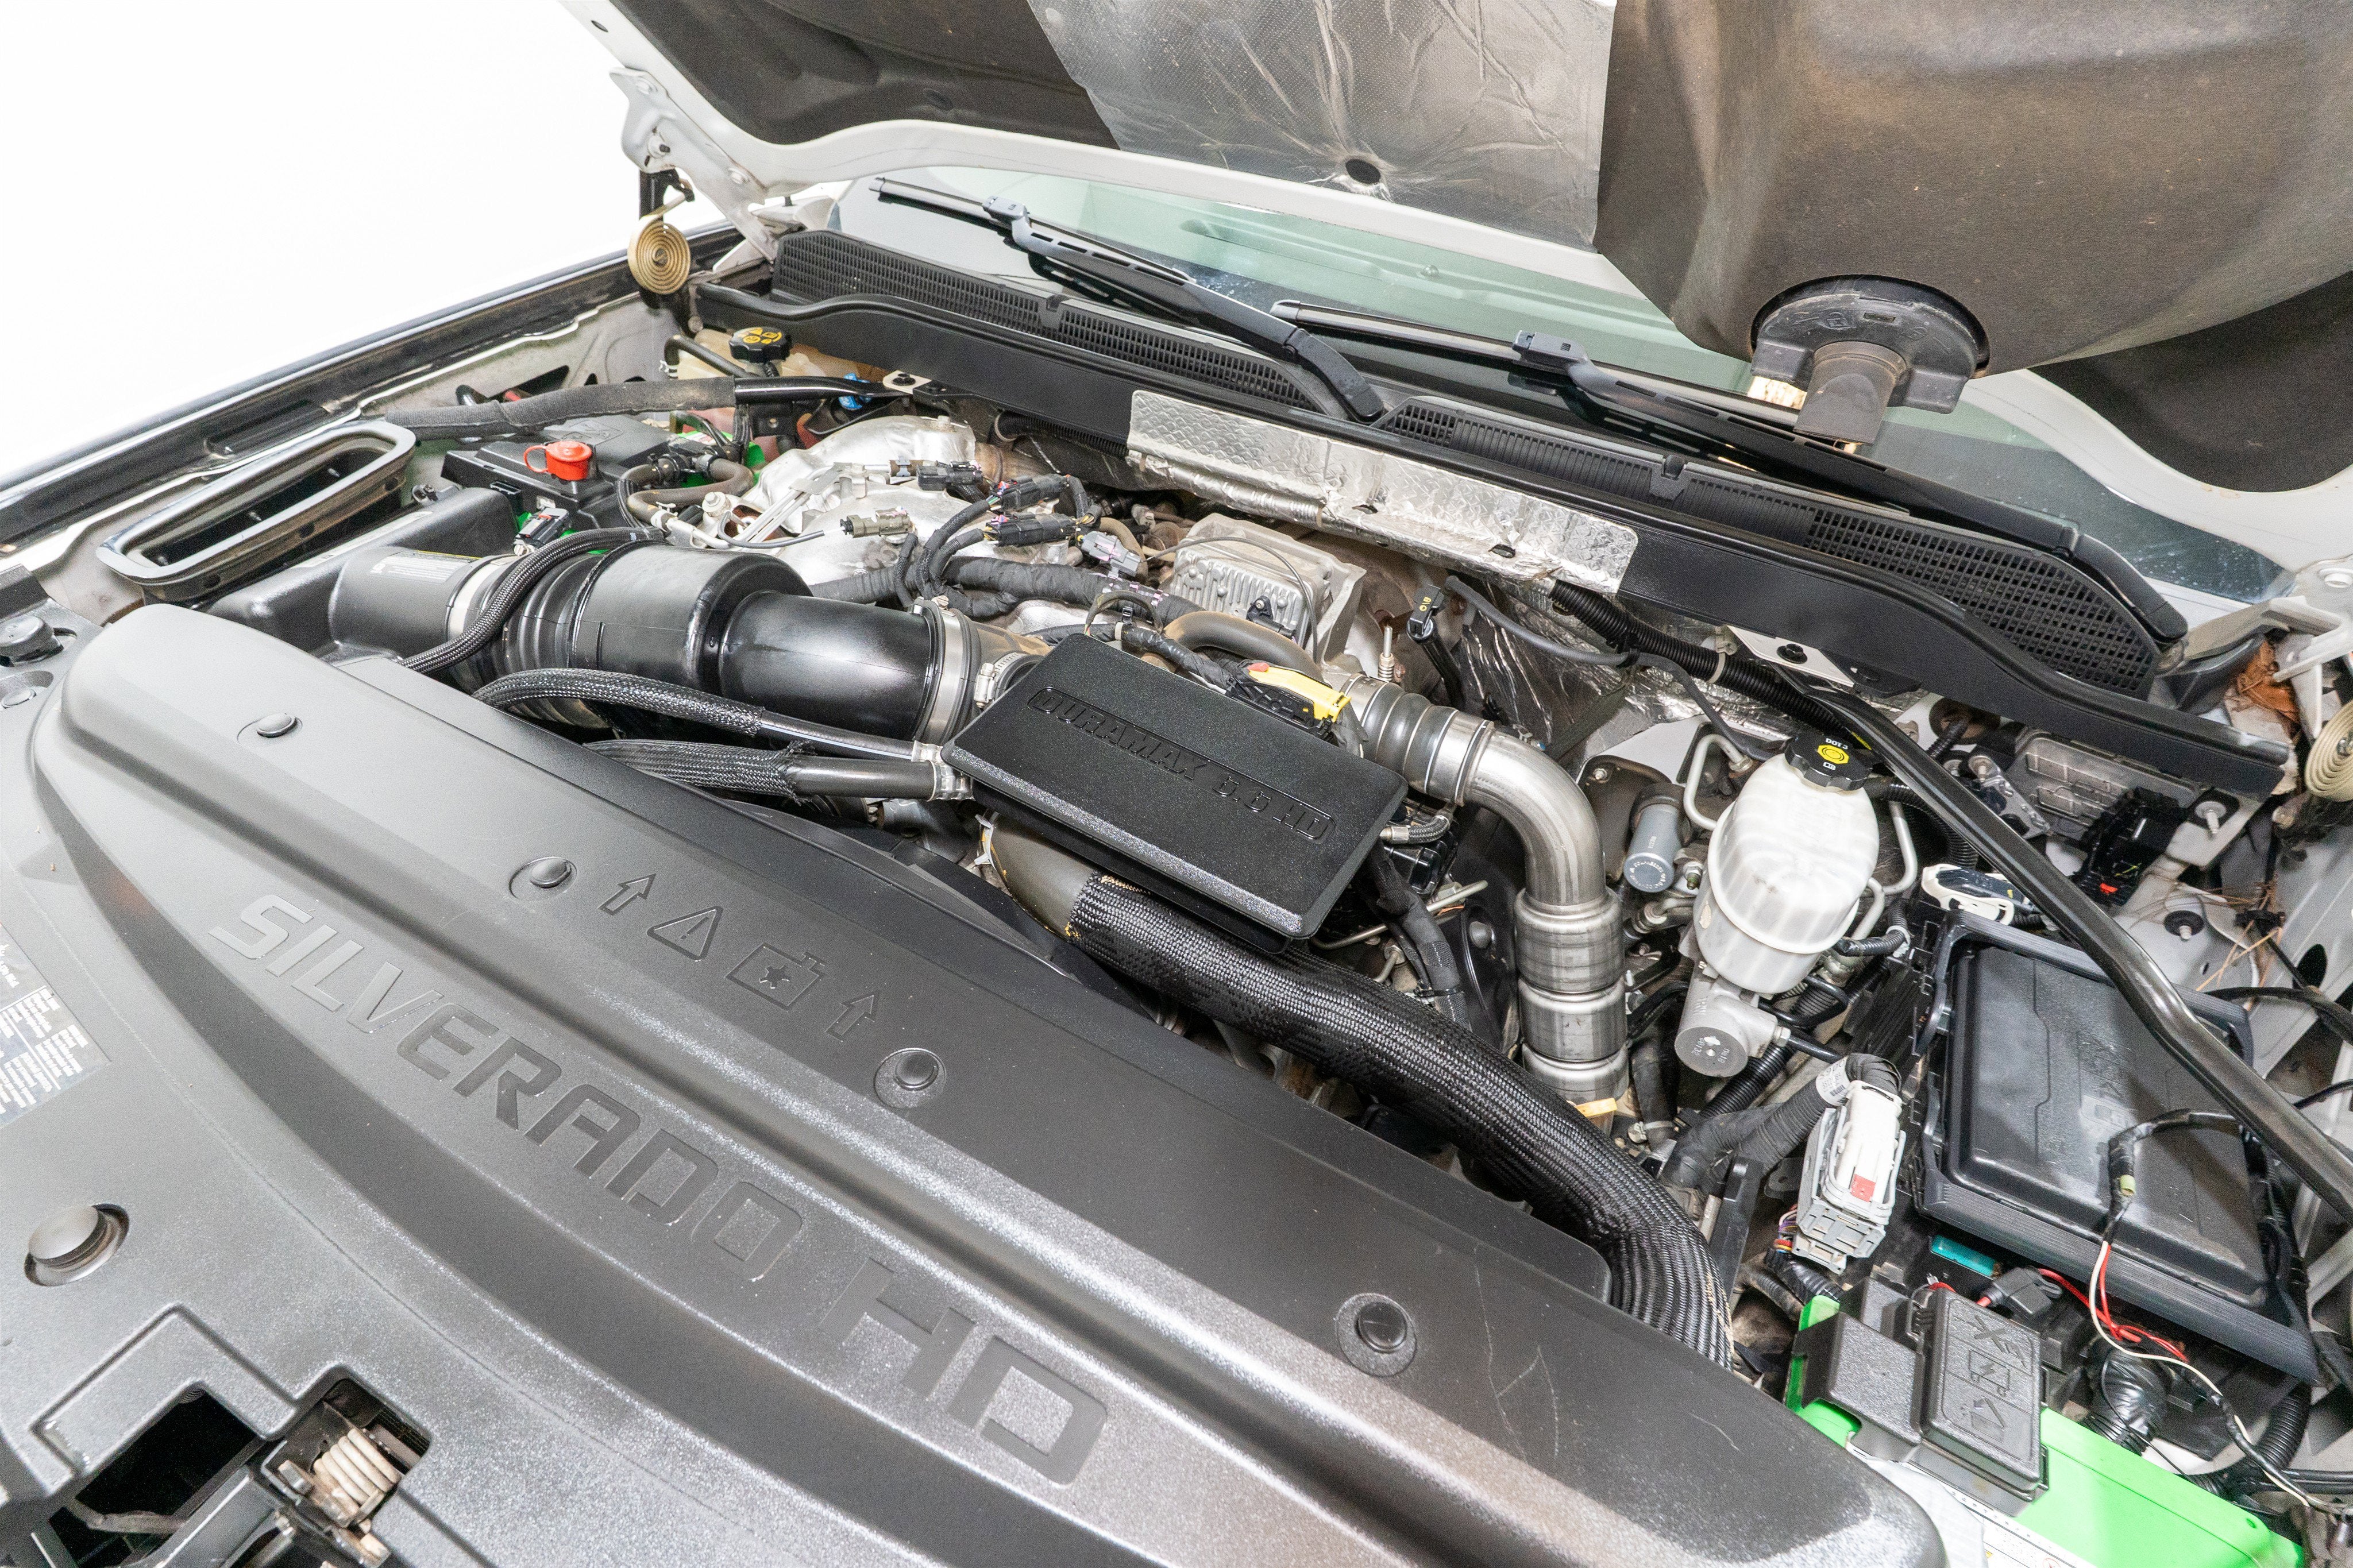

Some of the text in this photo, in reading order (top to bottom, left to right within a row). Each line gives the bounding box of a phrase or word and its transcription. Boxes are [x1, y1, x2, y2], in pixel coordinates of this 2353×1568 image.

[1033, 694, 1333, 840] DURAMAX 6.6 HD
[1825, 737, 1842, 747] DOT
[207, 894, 803, 1282] SILVERADO
[819, 1257, 1108, 1487] HD
